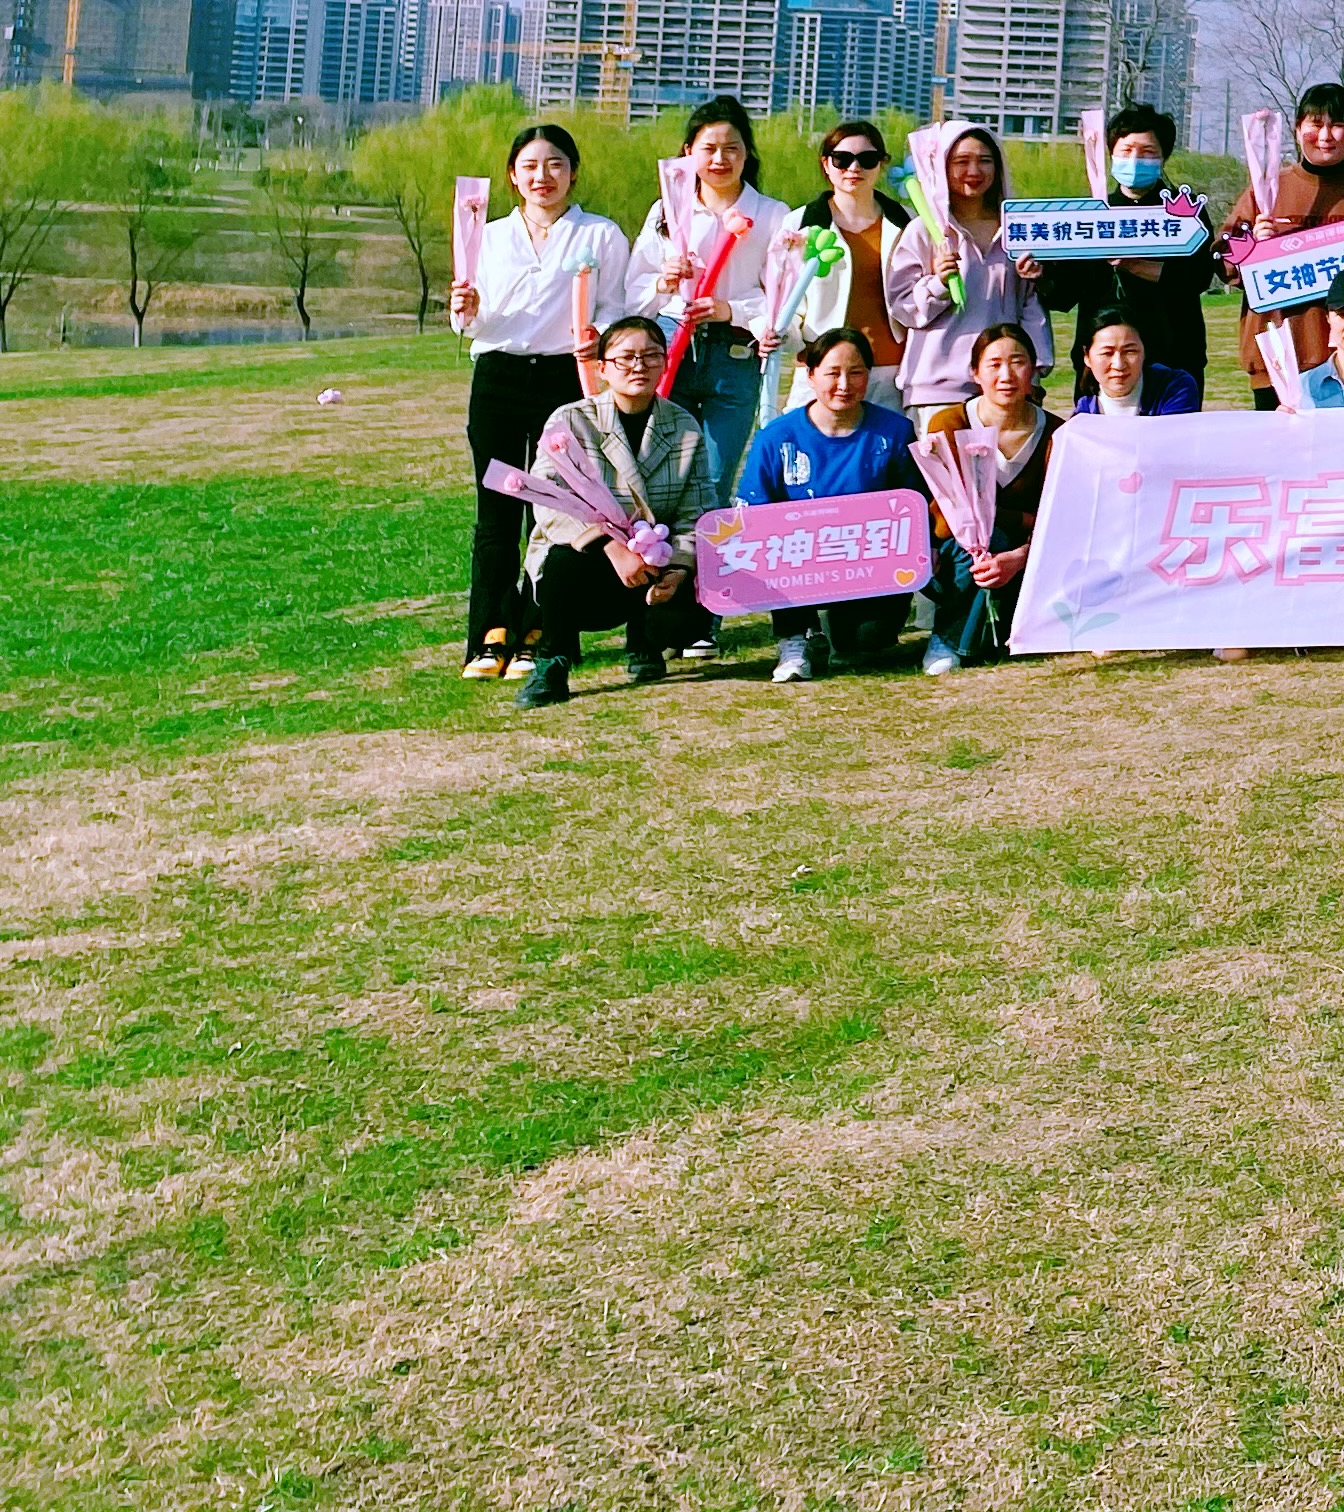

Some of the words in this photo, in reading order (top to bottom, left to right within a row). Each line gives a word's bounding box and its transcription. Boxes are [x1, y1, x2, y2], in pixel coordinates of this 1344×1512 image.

[1007, 218, 1183, 242] 集美貌与智慧共存
[716, 516, 912, 577] 女神驾到
[765, 569, 840, 590] WOMEN'S
[845, 565, 875, 582] DAY
